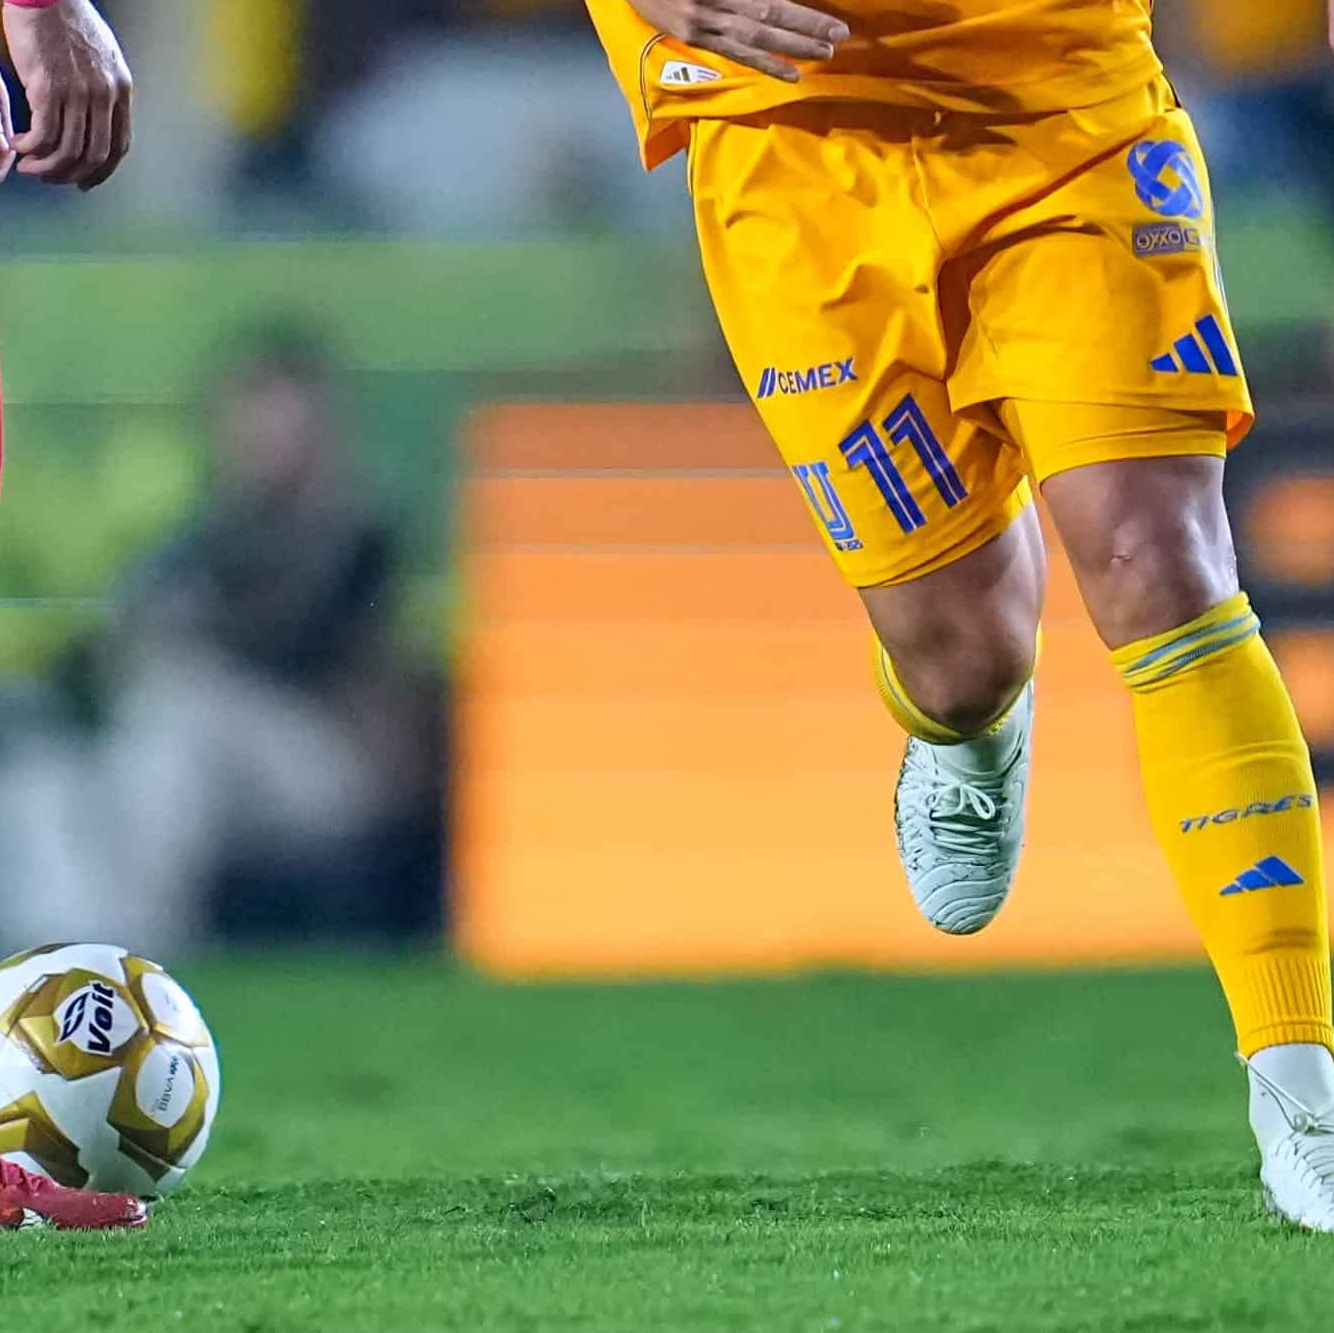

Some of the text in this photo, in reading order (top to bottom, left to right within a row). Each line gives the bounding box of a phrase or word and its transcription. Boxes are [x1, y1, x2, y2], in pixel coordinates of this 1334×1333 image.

[777, 357, 859, 396] CEMEX
[837, 393, 968, 535] 11
[1179, 793, 1313, 834] TIGRES
[88, 982, 115, 1054] Voit
